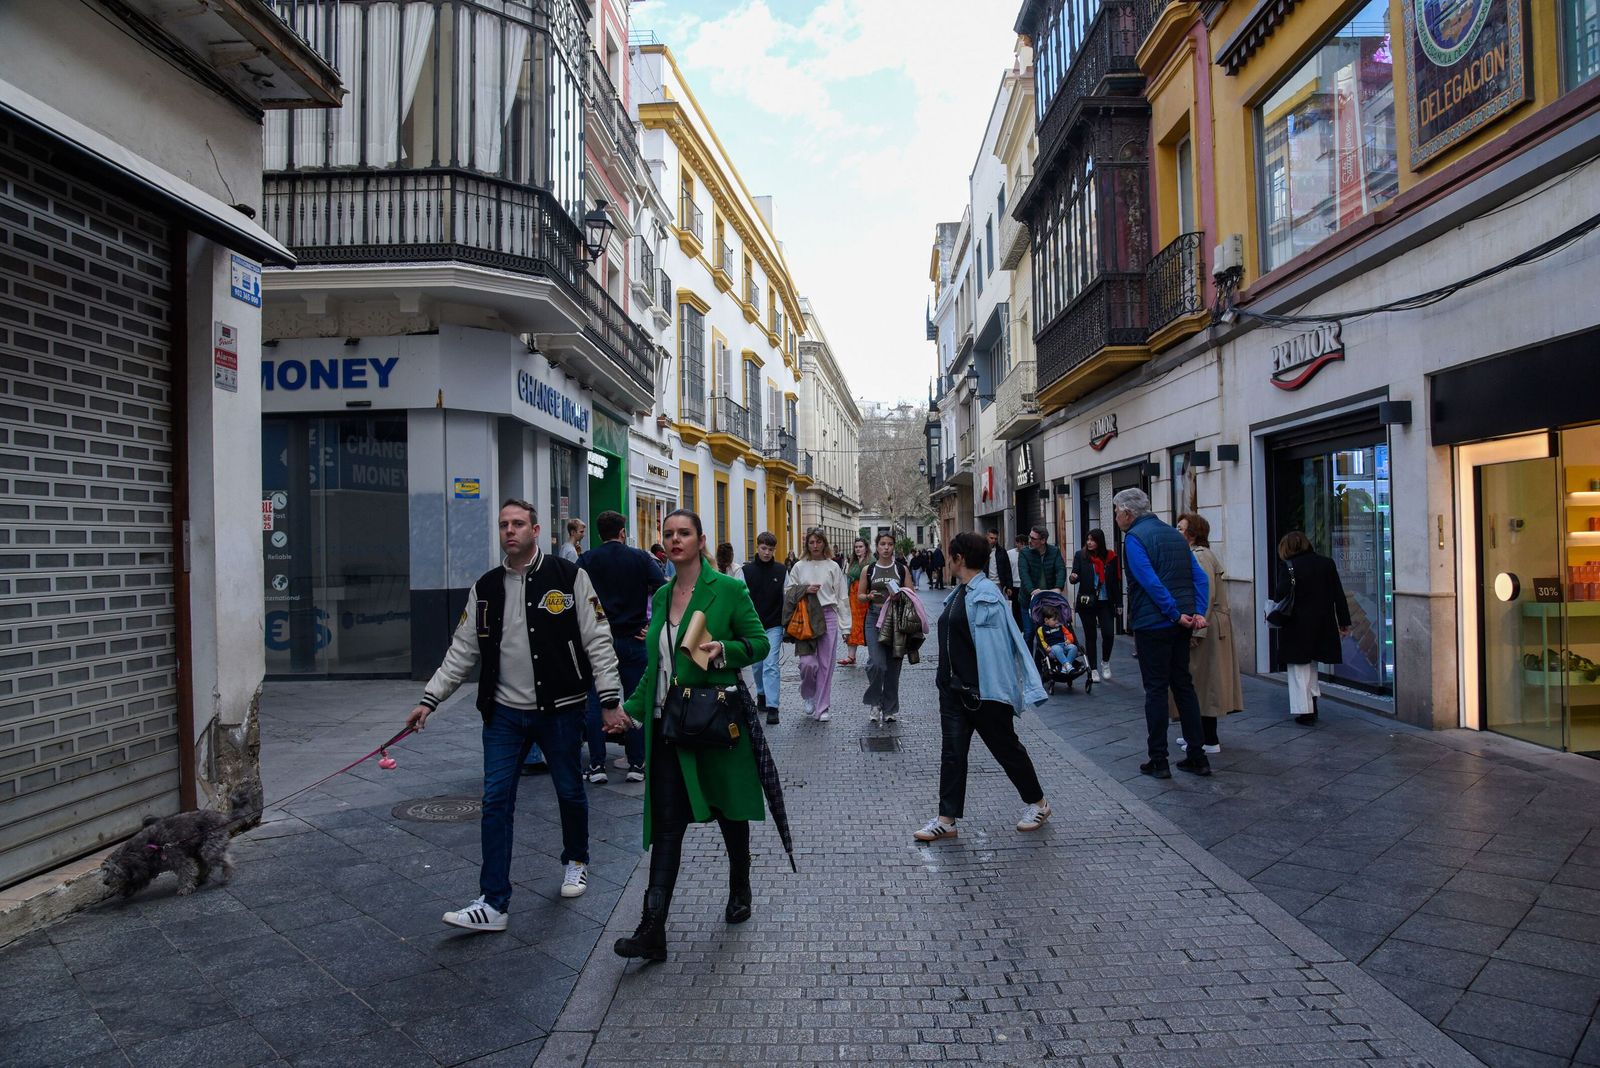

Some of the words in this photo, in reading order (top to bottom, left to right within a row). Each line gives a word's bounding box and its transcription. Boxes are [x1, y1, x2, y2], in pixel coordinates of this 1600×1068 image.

[1420, 41, 1505, 127] DELEGACION
[1271, 321, 1342, 373] PRIMOR
[517, 368, 561, 419] CHANGE
[561, 395, 589, 433] MONEY
[346, 435, 408, 461] CHANG
[1537, 587, 1559, 597] 30%
